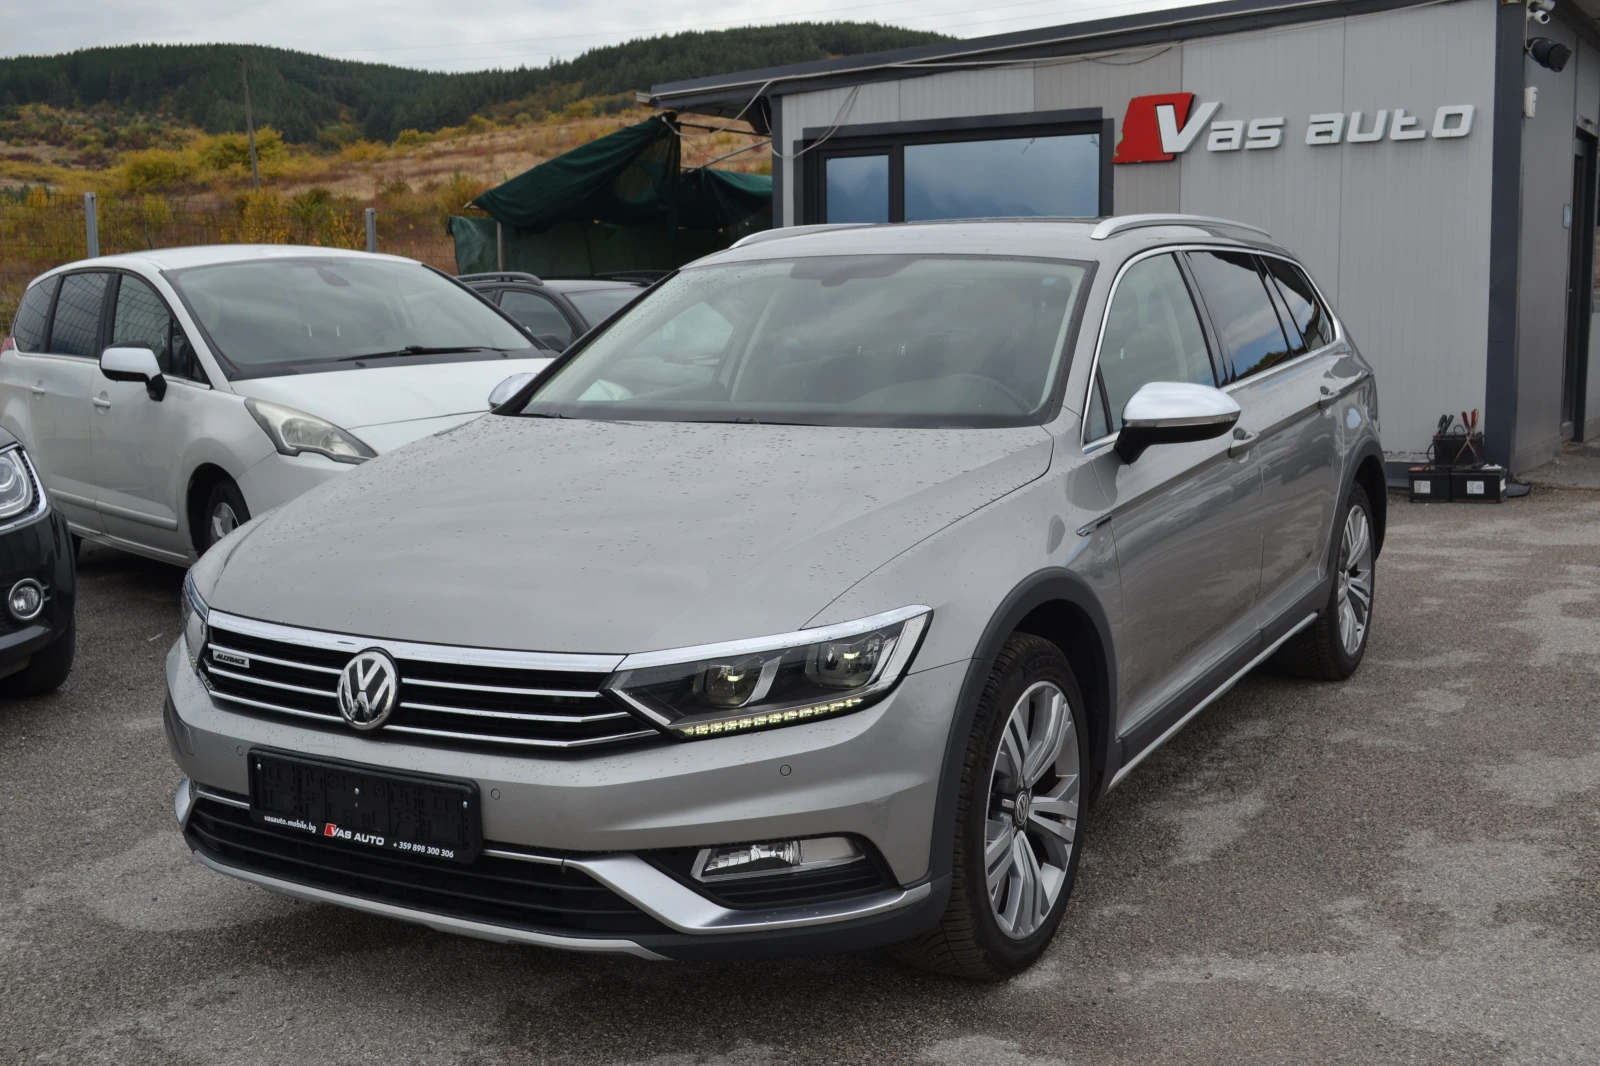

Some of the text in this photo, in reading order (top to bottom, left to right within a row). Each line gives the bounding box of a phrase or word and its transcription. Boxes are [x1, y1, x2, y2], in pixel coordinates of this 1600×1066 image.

[1154, 101, 1477, 154] Vas auto
[263, 815, 317, 834] vasauto.mobile.bg
[330, 826, 385, 846] VAS AUTO
[398, 841, 412, 851] 359
[412, 843, 426, 853] 898
[426, 846, 440, 856] 300
[440, 848, 454, 859] 306
